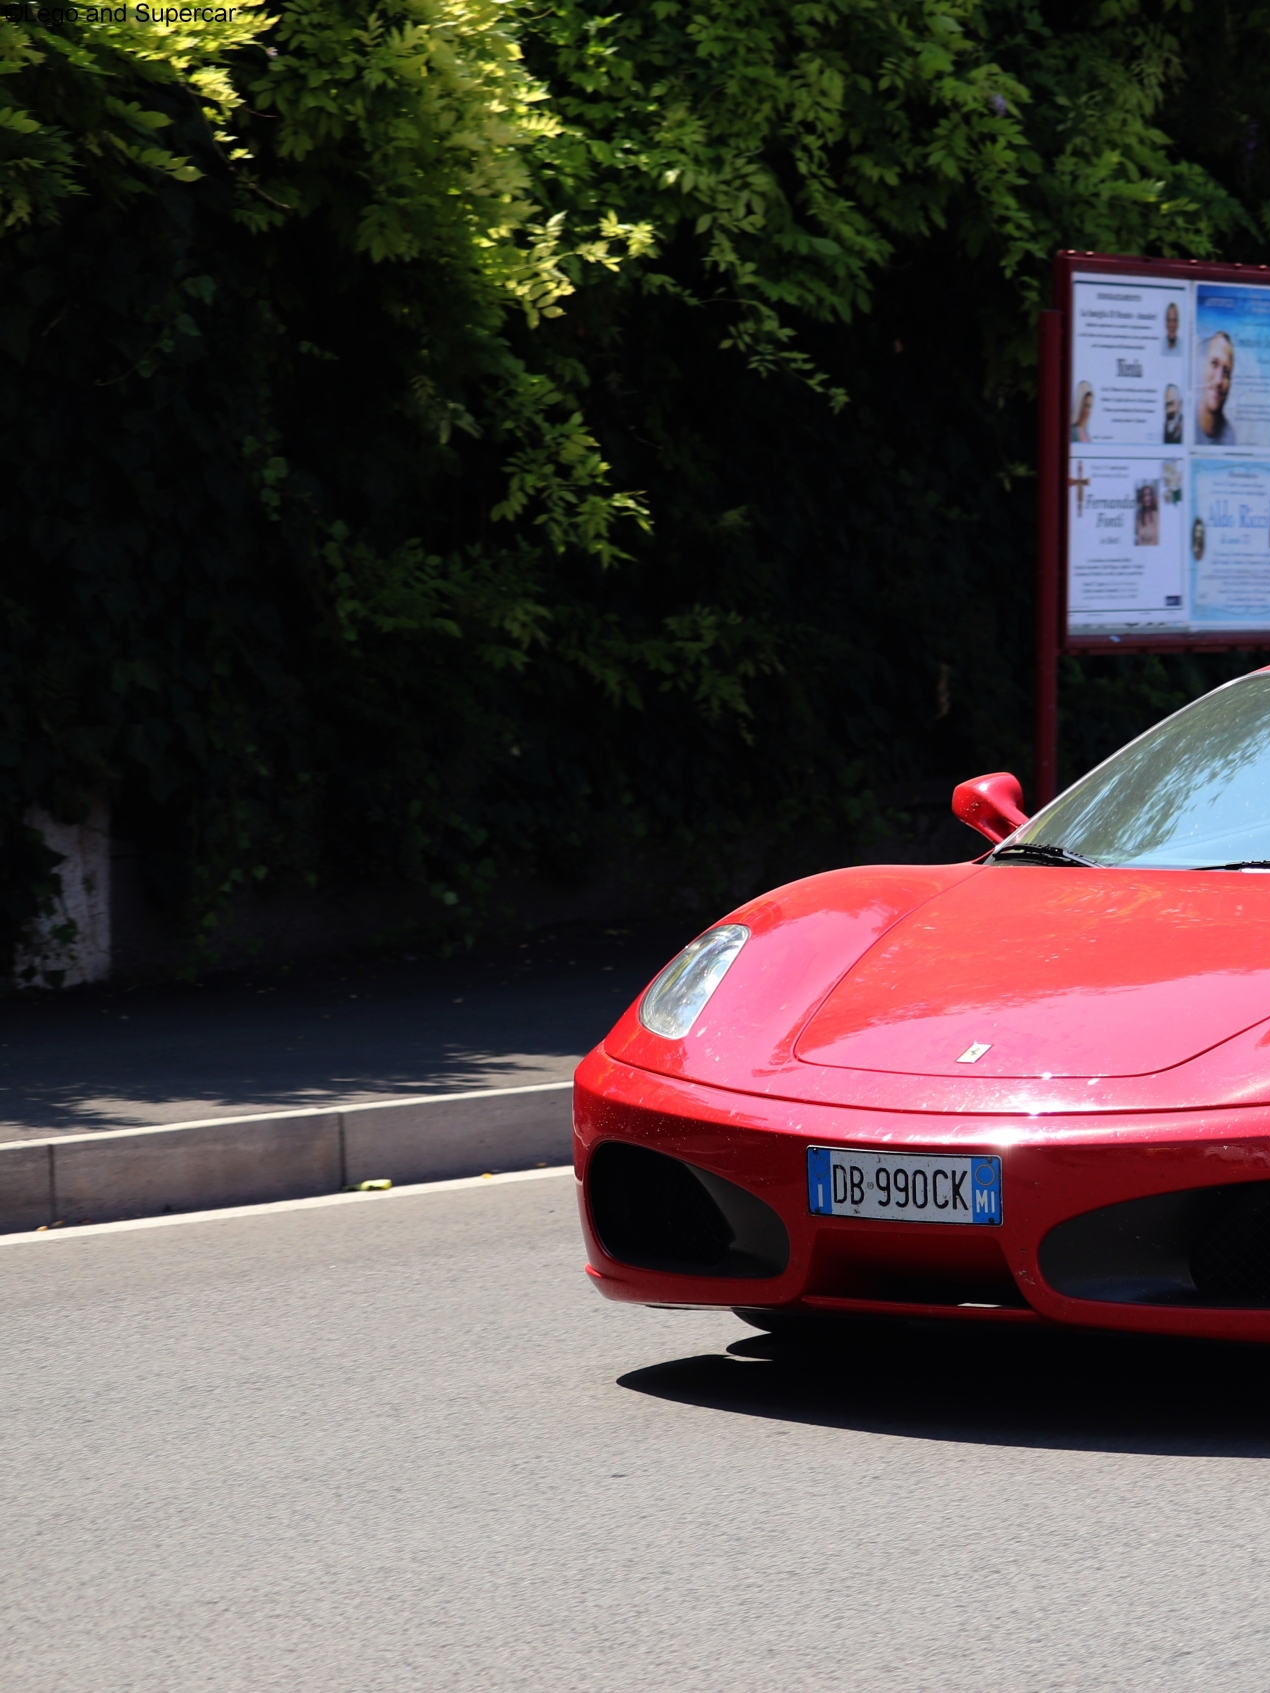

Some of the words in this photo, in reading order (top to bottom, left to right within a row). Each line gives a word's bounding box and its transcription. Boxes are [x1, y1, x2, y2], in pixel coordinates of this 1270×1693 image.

[832, 1164, 865, 1205] DB
[875, 1167, 969, 1211] 990CK
[975, 1189, 996, 1214] MI
